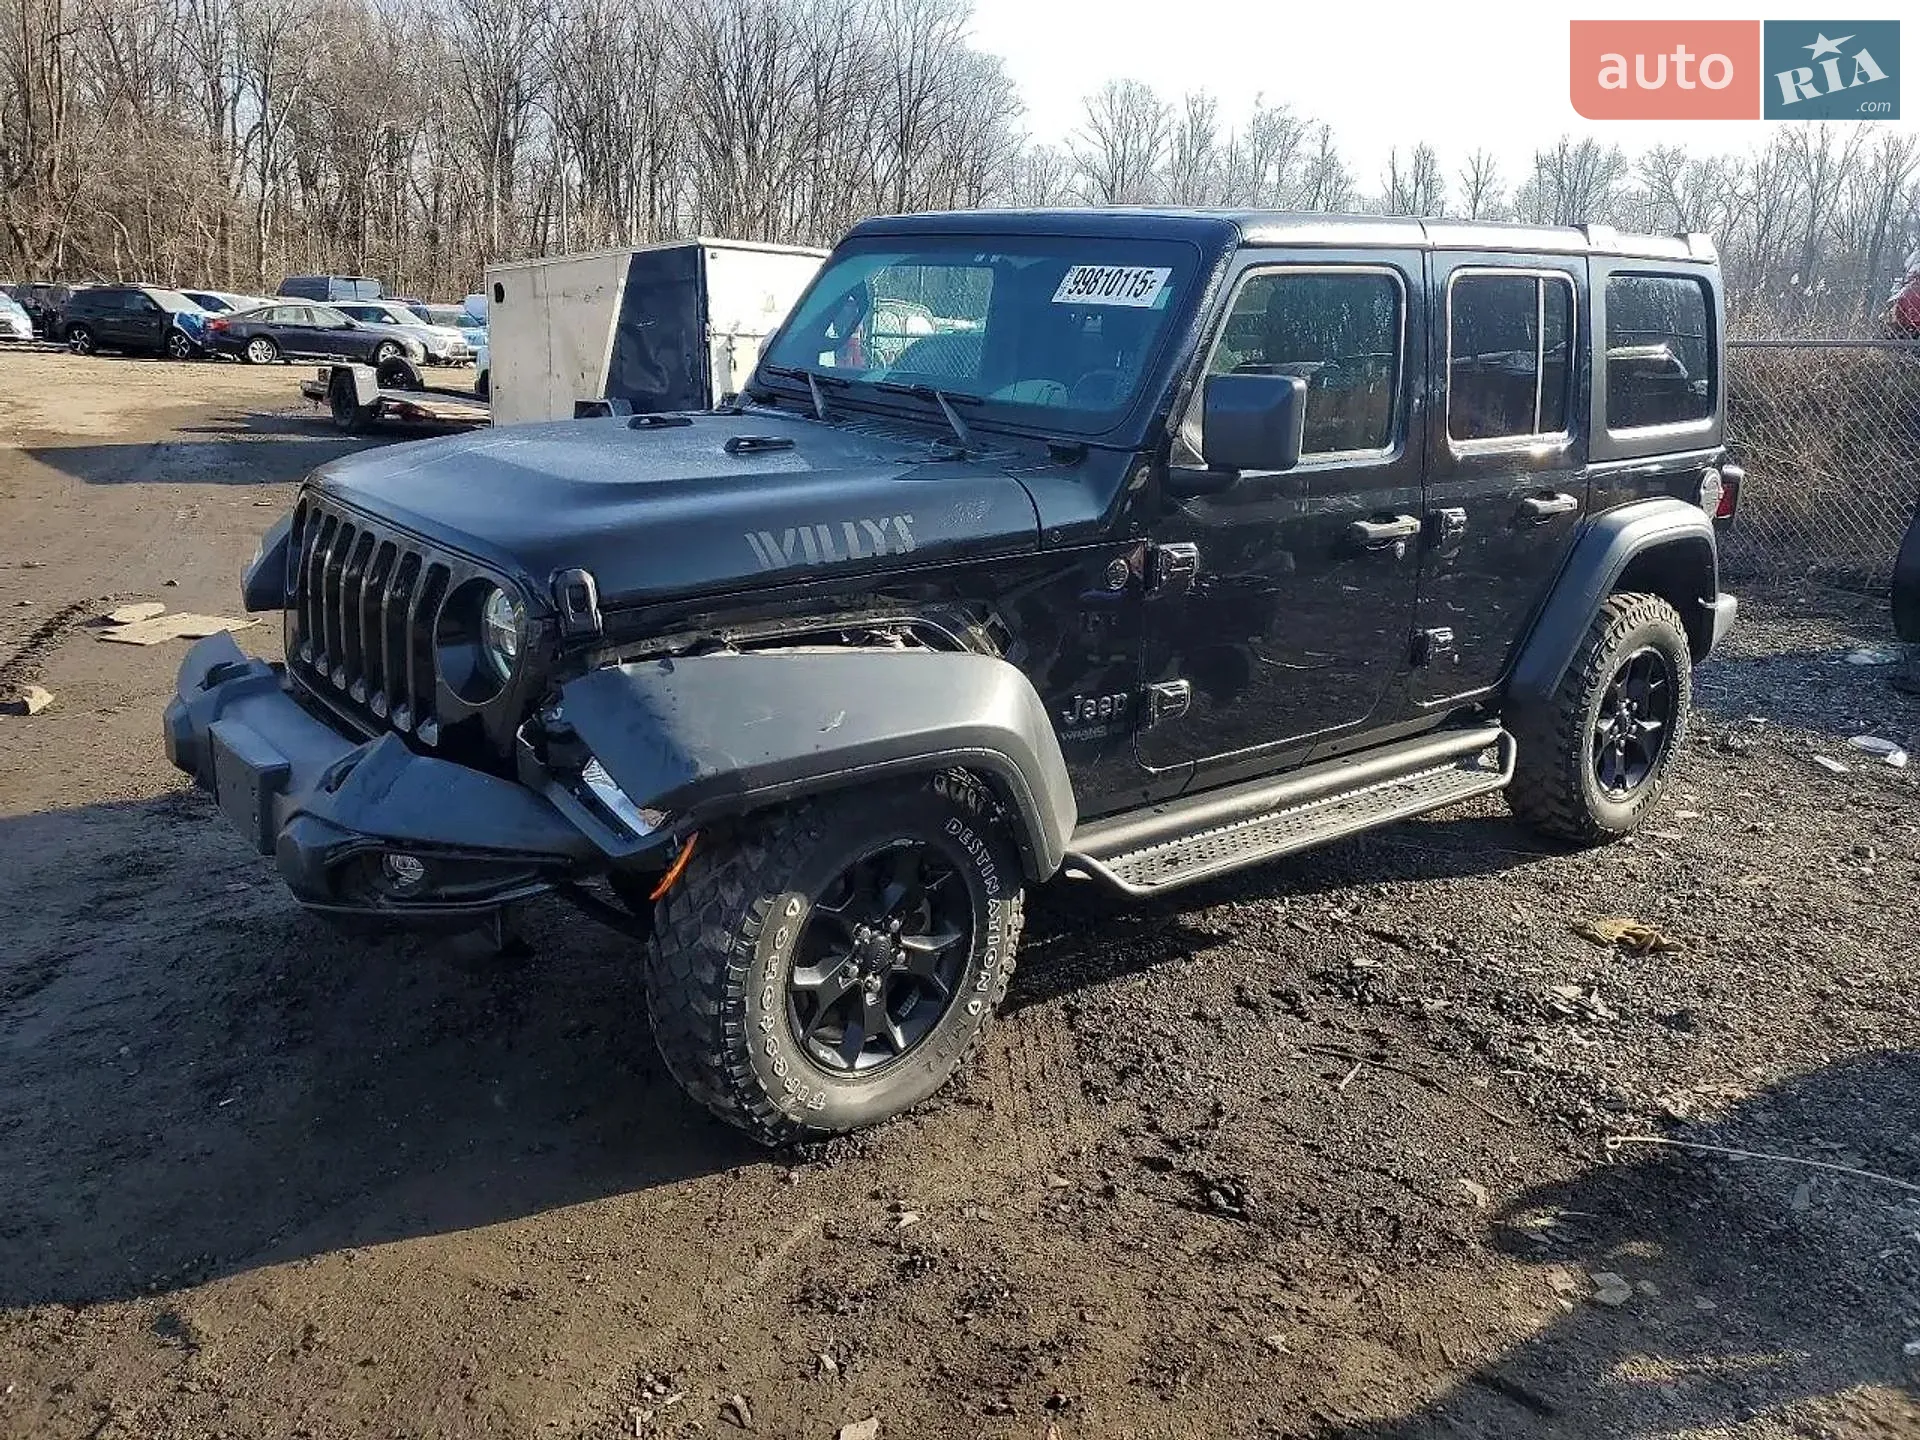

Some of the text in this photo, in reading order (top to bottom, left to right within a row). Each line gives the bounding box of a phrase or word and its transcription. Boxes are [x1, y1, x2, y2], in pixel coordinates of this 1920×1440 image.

[744, 513, 918, 570] WILLYS
[1062, 693, 1128, 721] Jeep
[946, 816, 1002, 992] DESTINATION
